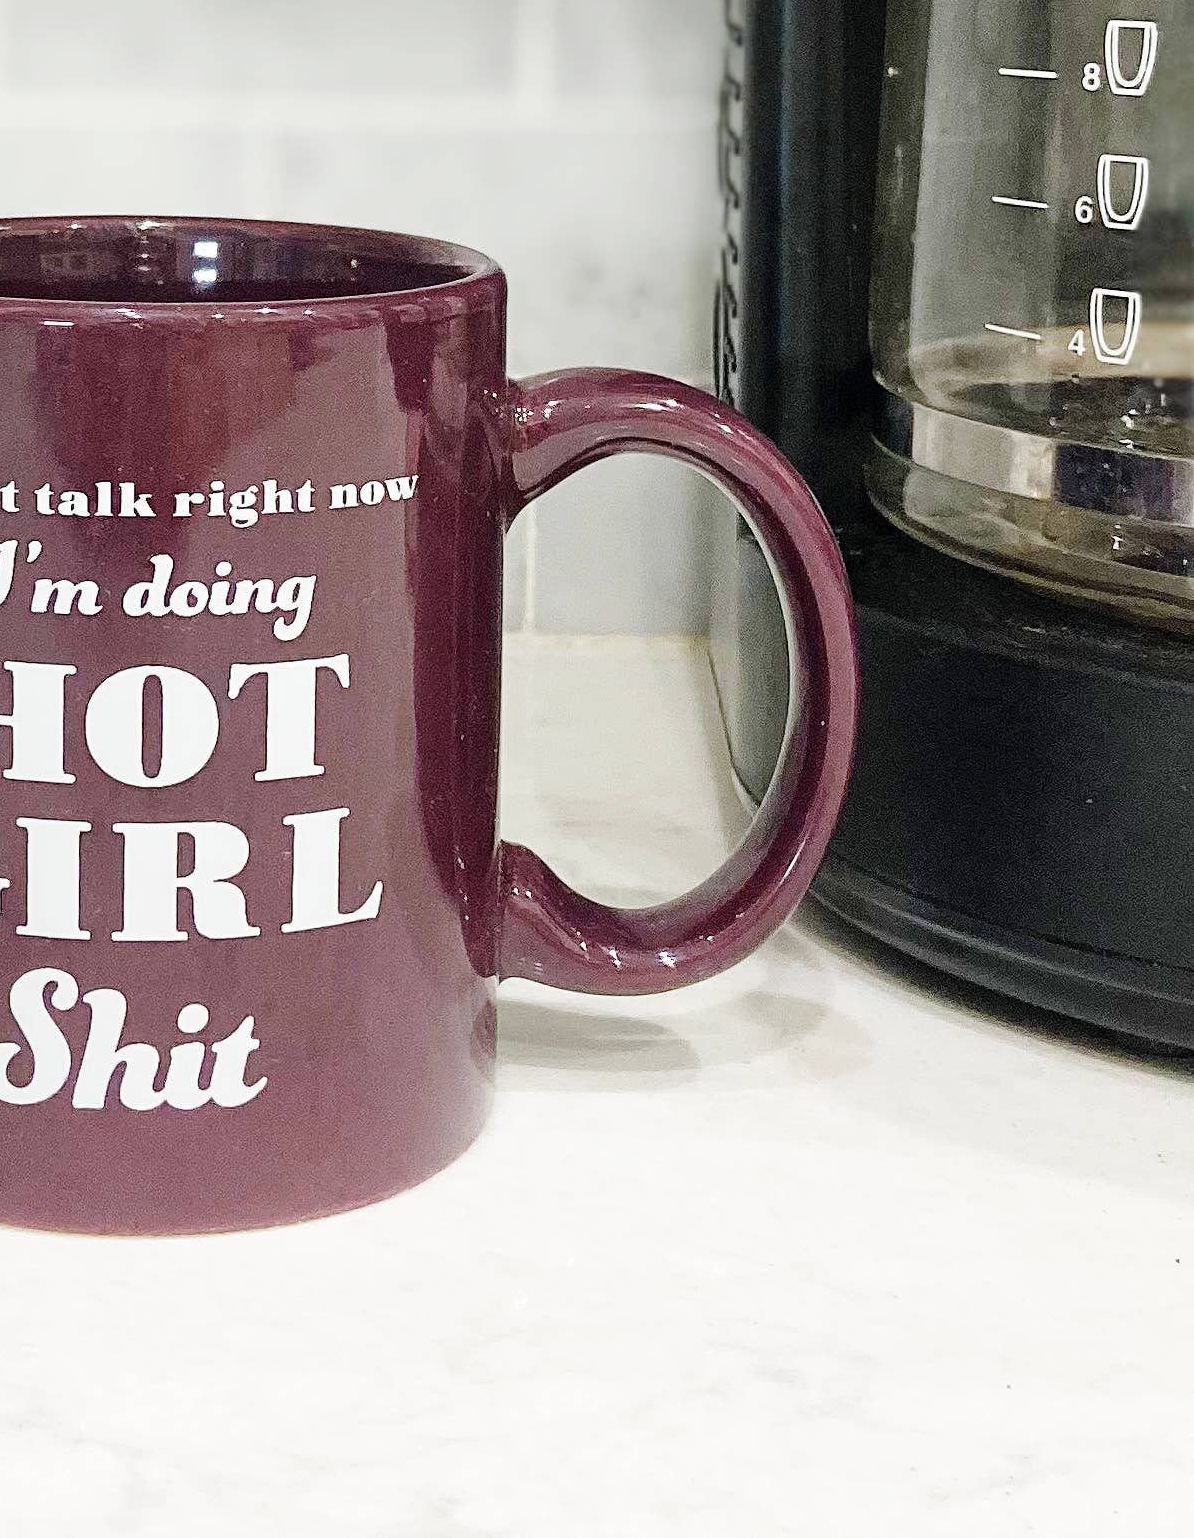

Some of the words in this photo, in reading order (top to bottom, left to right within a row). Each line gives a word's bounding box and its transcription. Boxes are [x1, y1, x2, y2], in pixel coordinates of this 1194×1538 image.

[1081, 62, 1101, 92] 8
[1074, 195, 1094, 224] 6
[1067, 329, 1087, 357] 4
[34, 481, 157, 517] talk
[172, 479, 316, 529] right
[328, 473, 420, 510] now
[122, 554, 317, 642] doing
